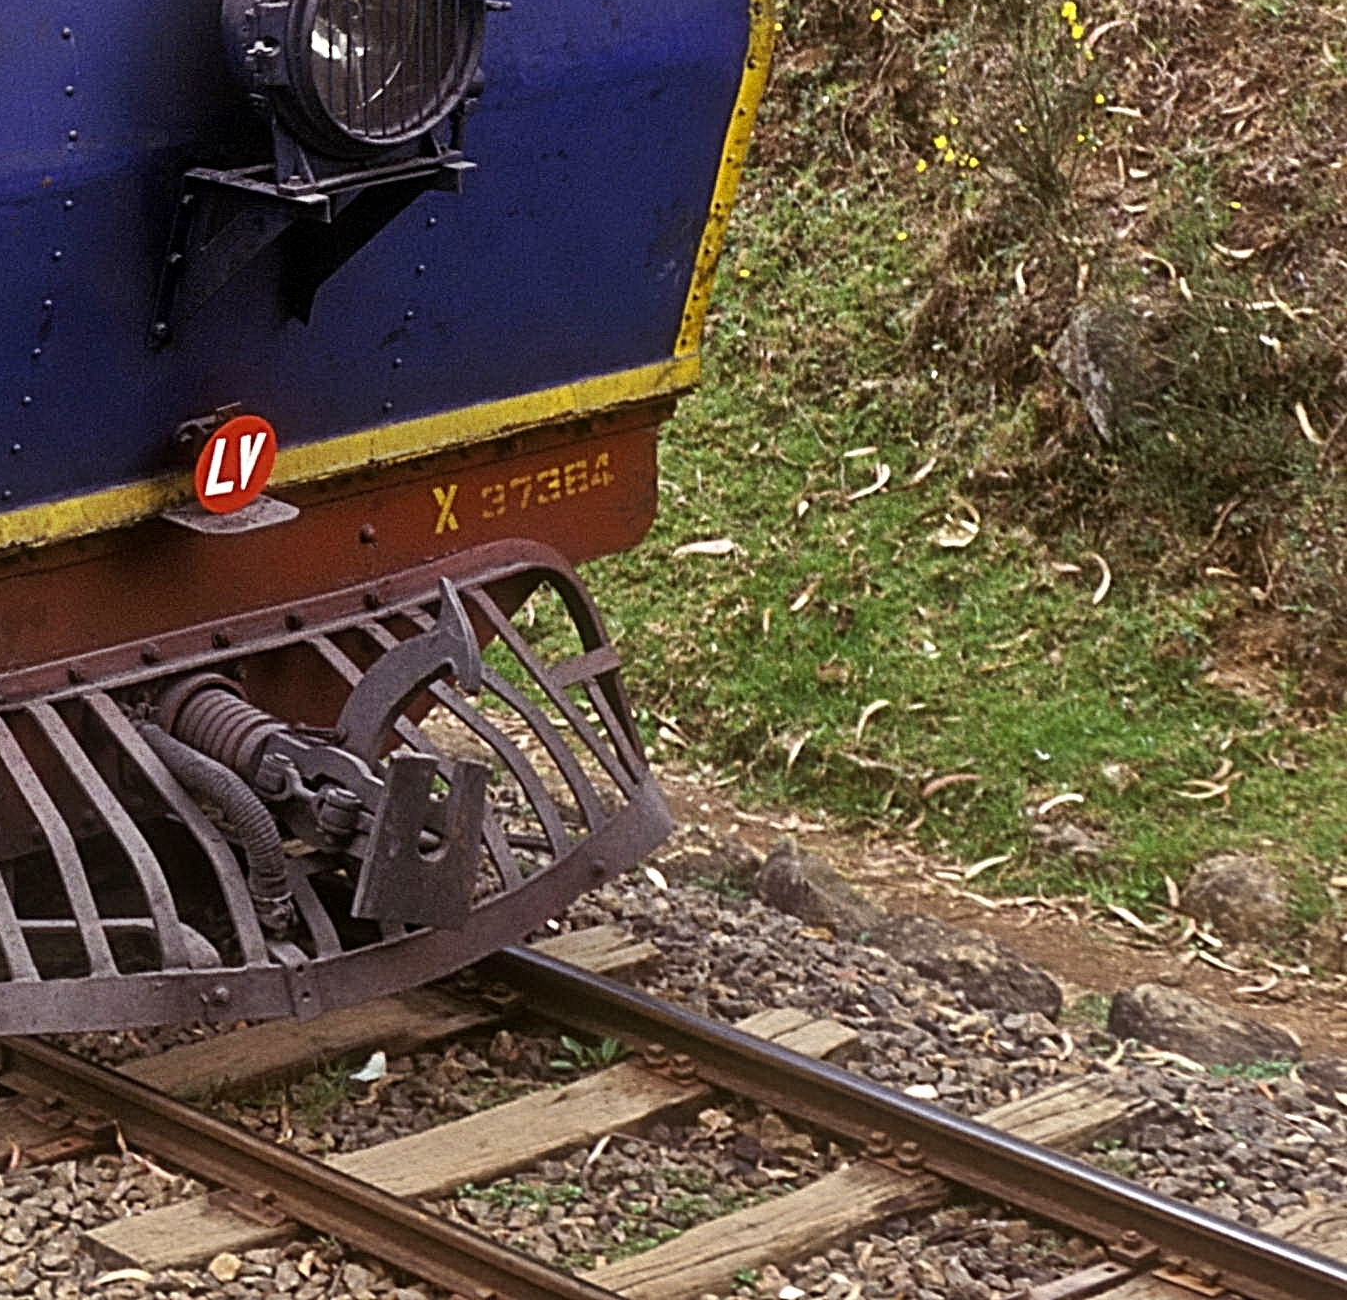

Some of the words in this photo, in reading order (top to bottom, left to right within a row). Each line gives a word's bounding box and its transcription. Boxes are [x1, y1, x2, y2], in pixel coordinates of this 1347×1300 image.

[204, 432, 268, 498] LV
[432, 484, 459, 536] X
[481, 452, 615, 519] 37384
